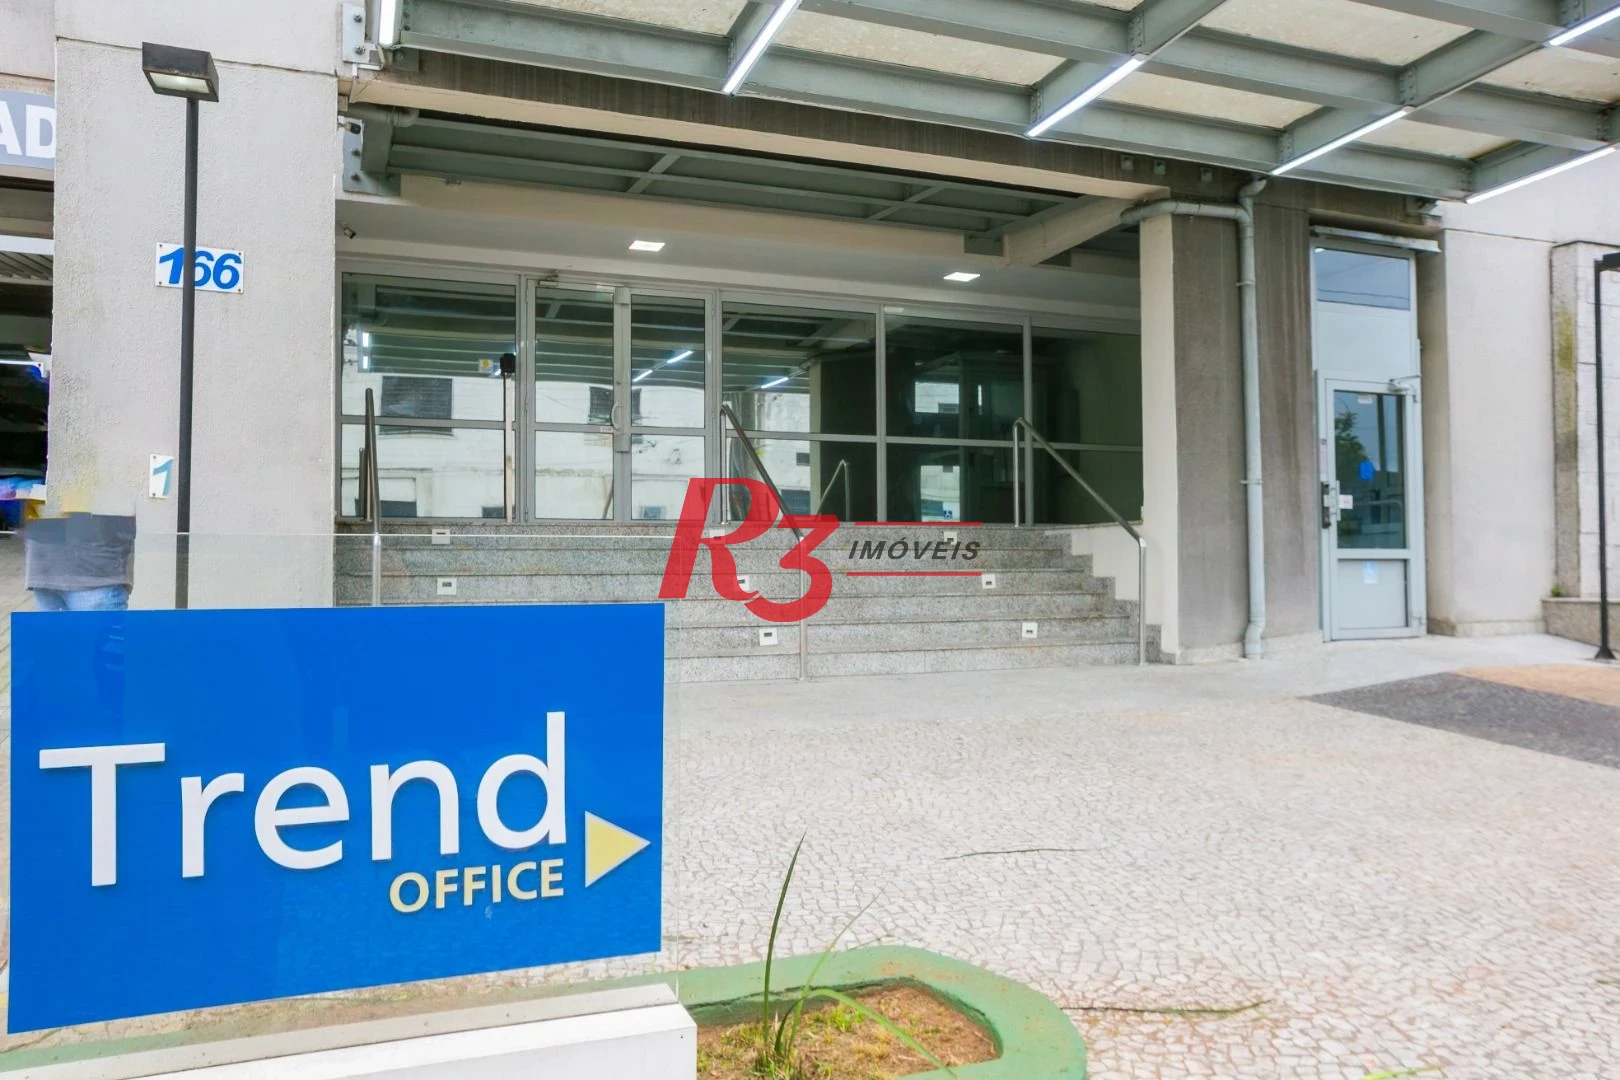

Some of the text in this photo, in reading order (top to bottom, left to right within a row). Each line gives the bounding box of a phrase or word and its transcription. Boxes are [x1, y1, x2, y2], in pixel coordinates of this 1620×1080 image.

[159, 247, 242, 289] 166
[39, 711, 567, 887] Trend
[389, 858, 565, 913] OFFICE
